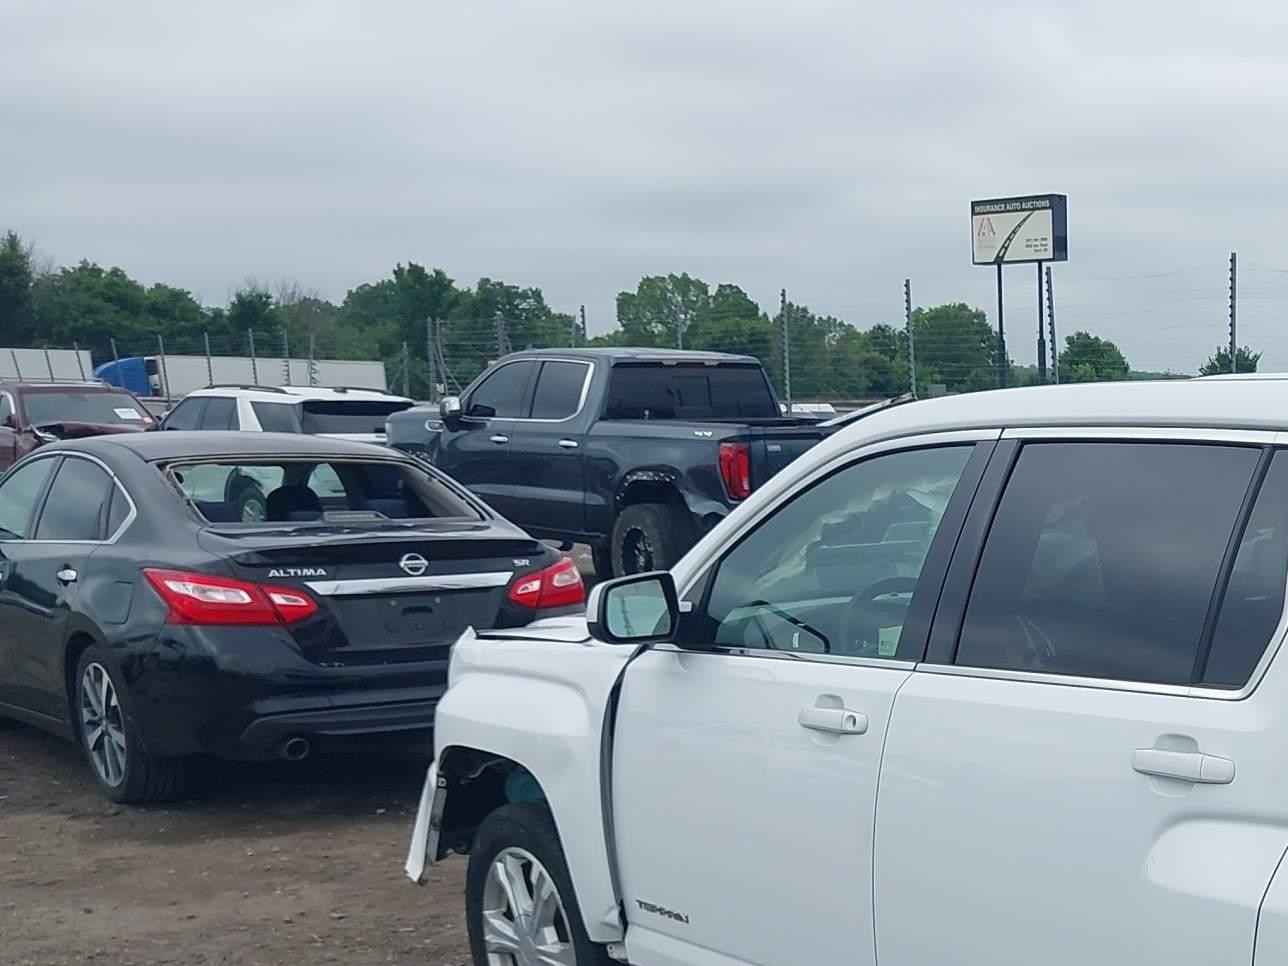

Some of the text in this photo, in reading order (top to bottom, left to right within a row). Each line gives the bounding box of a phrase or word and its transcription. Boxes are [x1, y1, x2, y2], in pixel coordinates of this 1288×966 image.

[975, 200, 1050, 213] INSURANCE AUTO AUCTIONS
[513, 558, 530, 567] SR
[268, 566, 327, 578] ALTIMA
